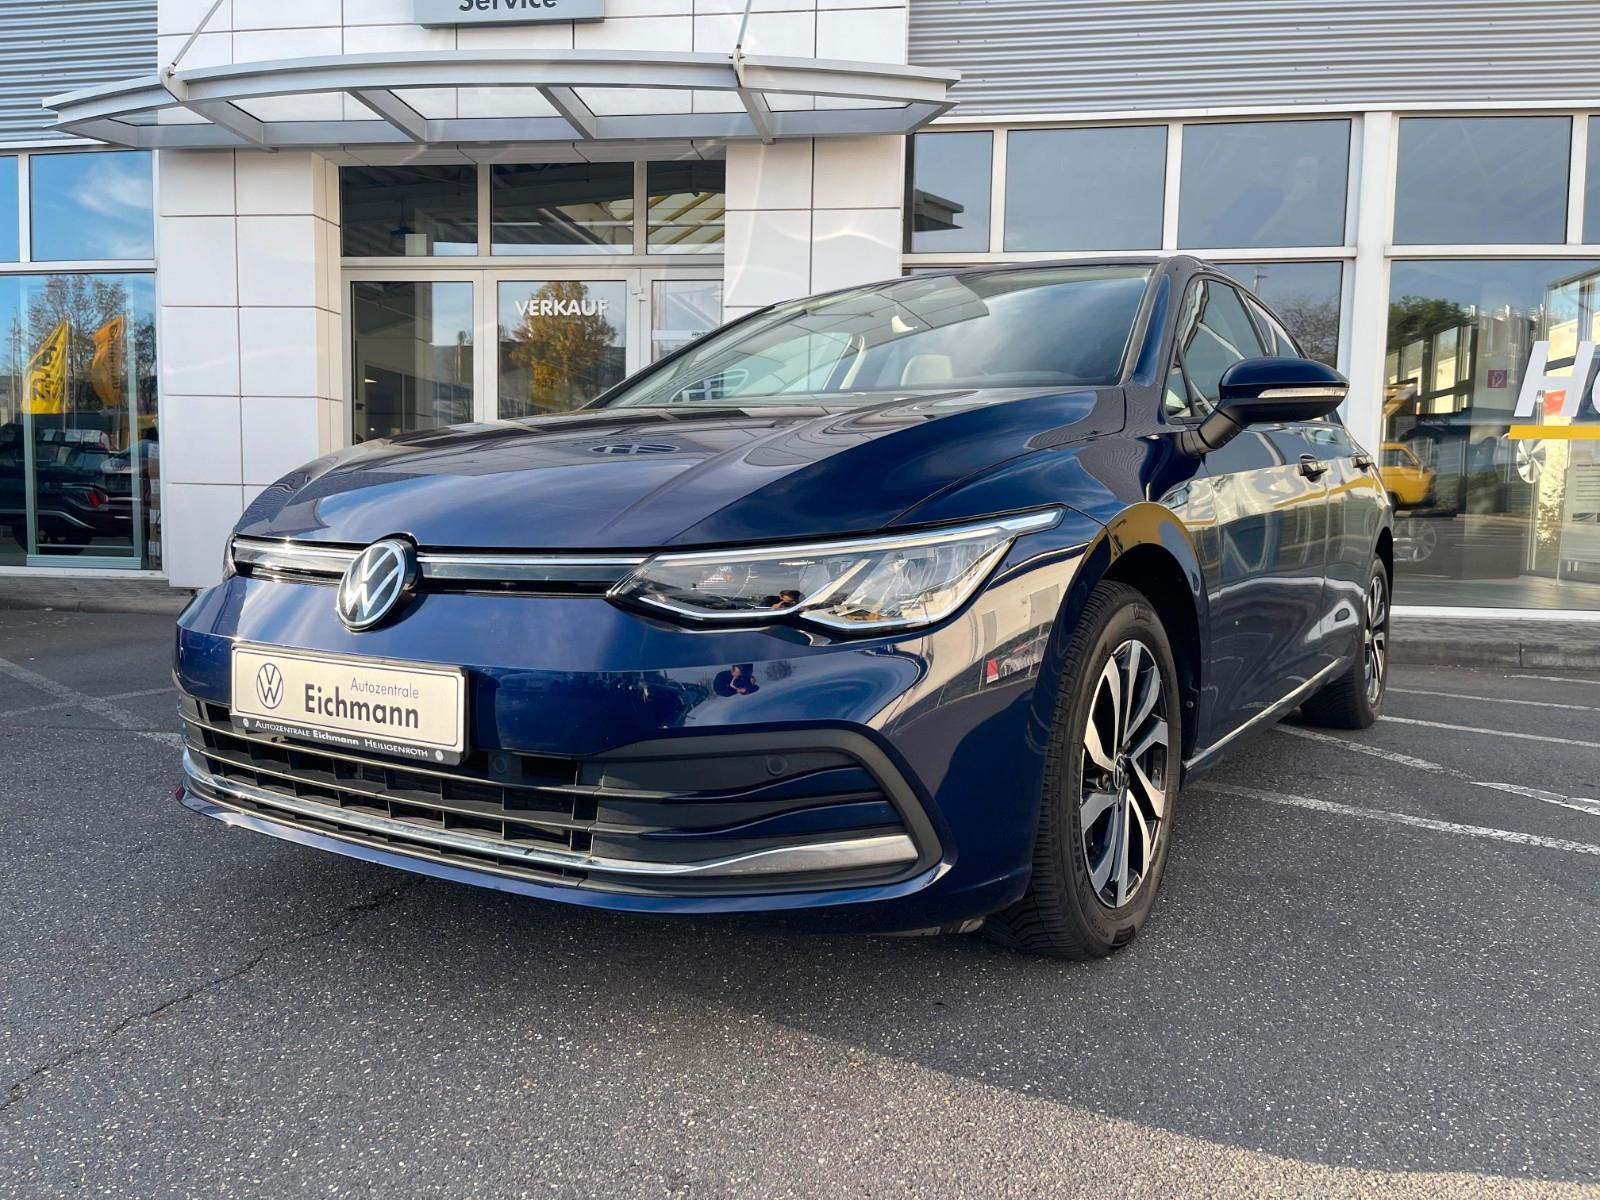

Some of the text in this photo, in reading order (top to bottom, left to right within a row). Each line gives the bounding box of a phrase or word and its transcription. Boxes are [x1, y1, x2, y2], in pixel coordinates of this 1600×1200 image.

[514, 299, 608, 316] VERKAUF
[1513, 340, 1600, 417] H
[350, 677, 419, 699] Autozentrale
[304, 683, 419, 729] Eichmann
[312, 730, 359, 746] Eichmann
